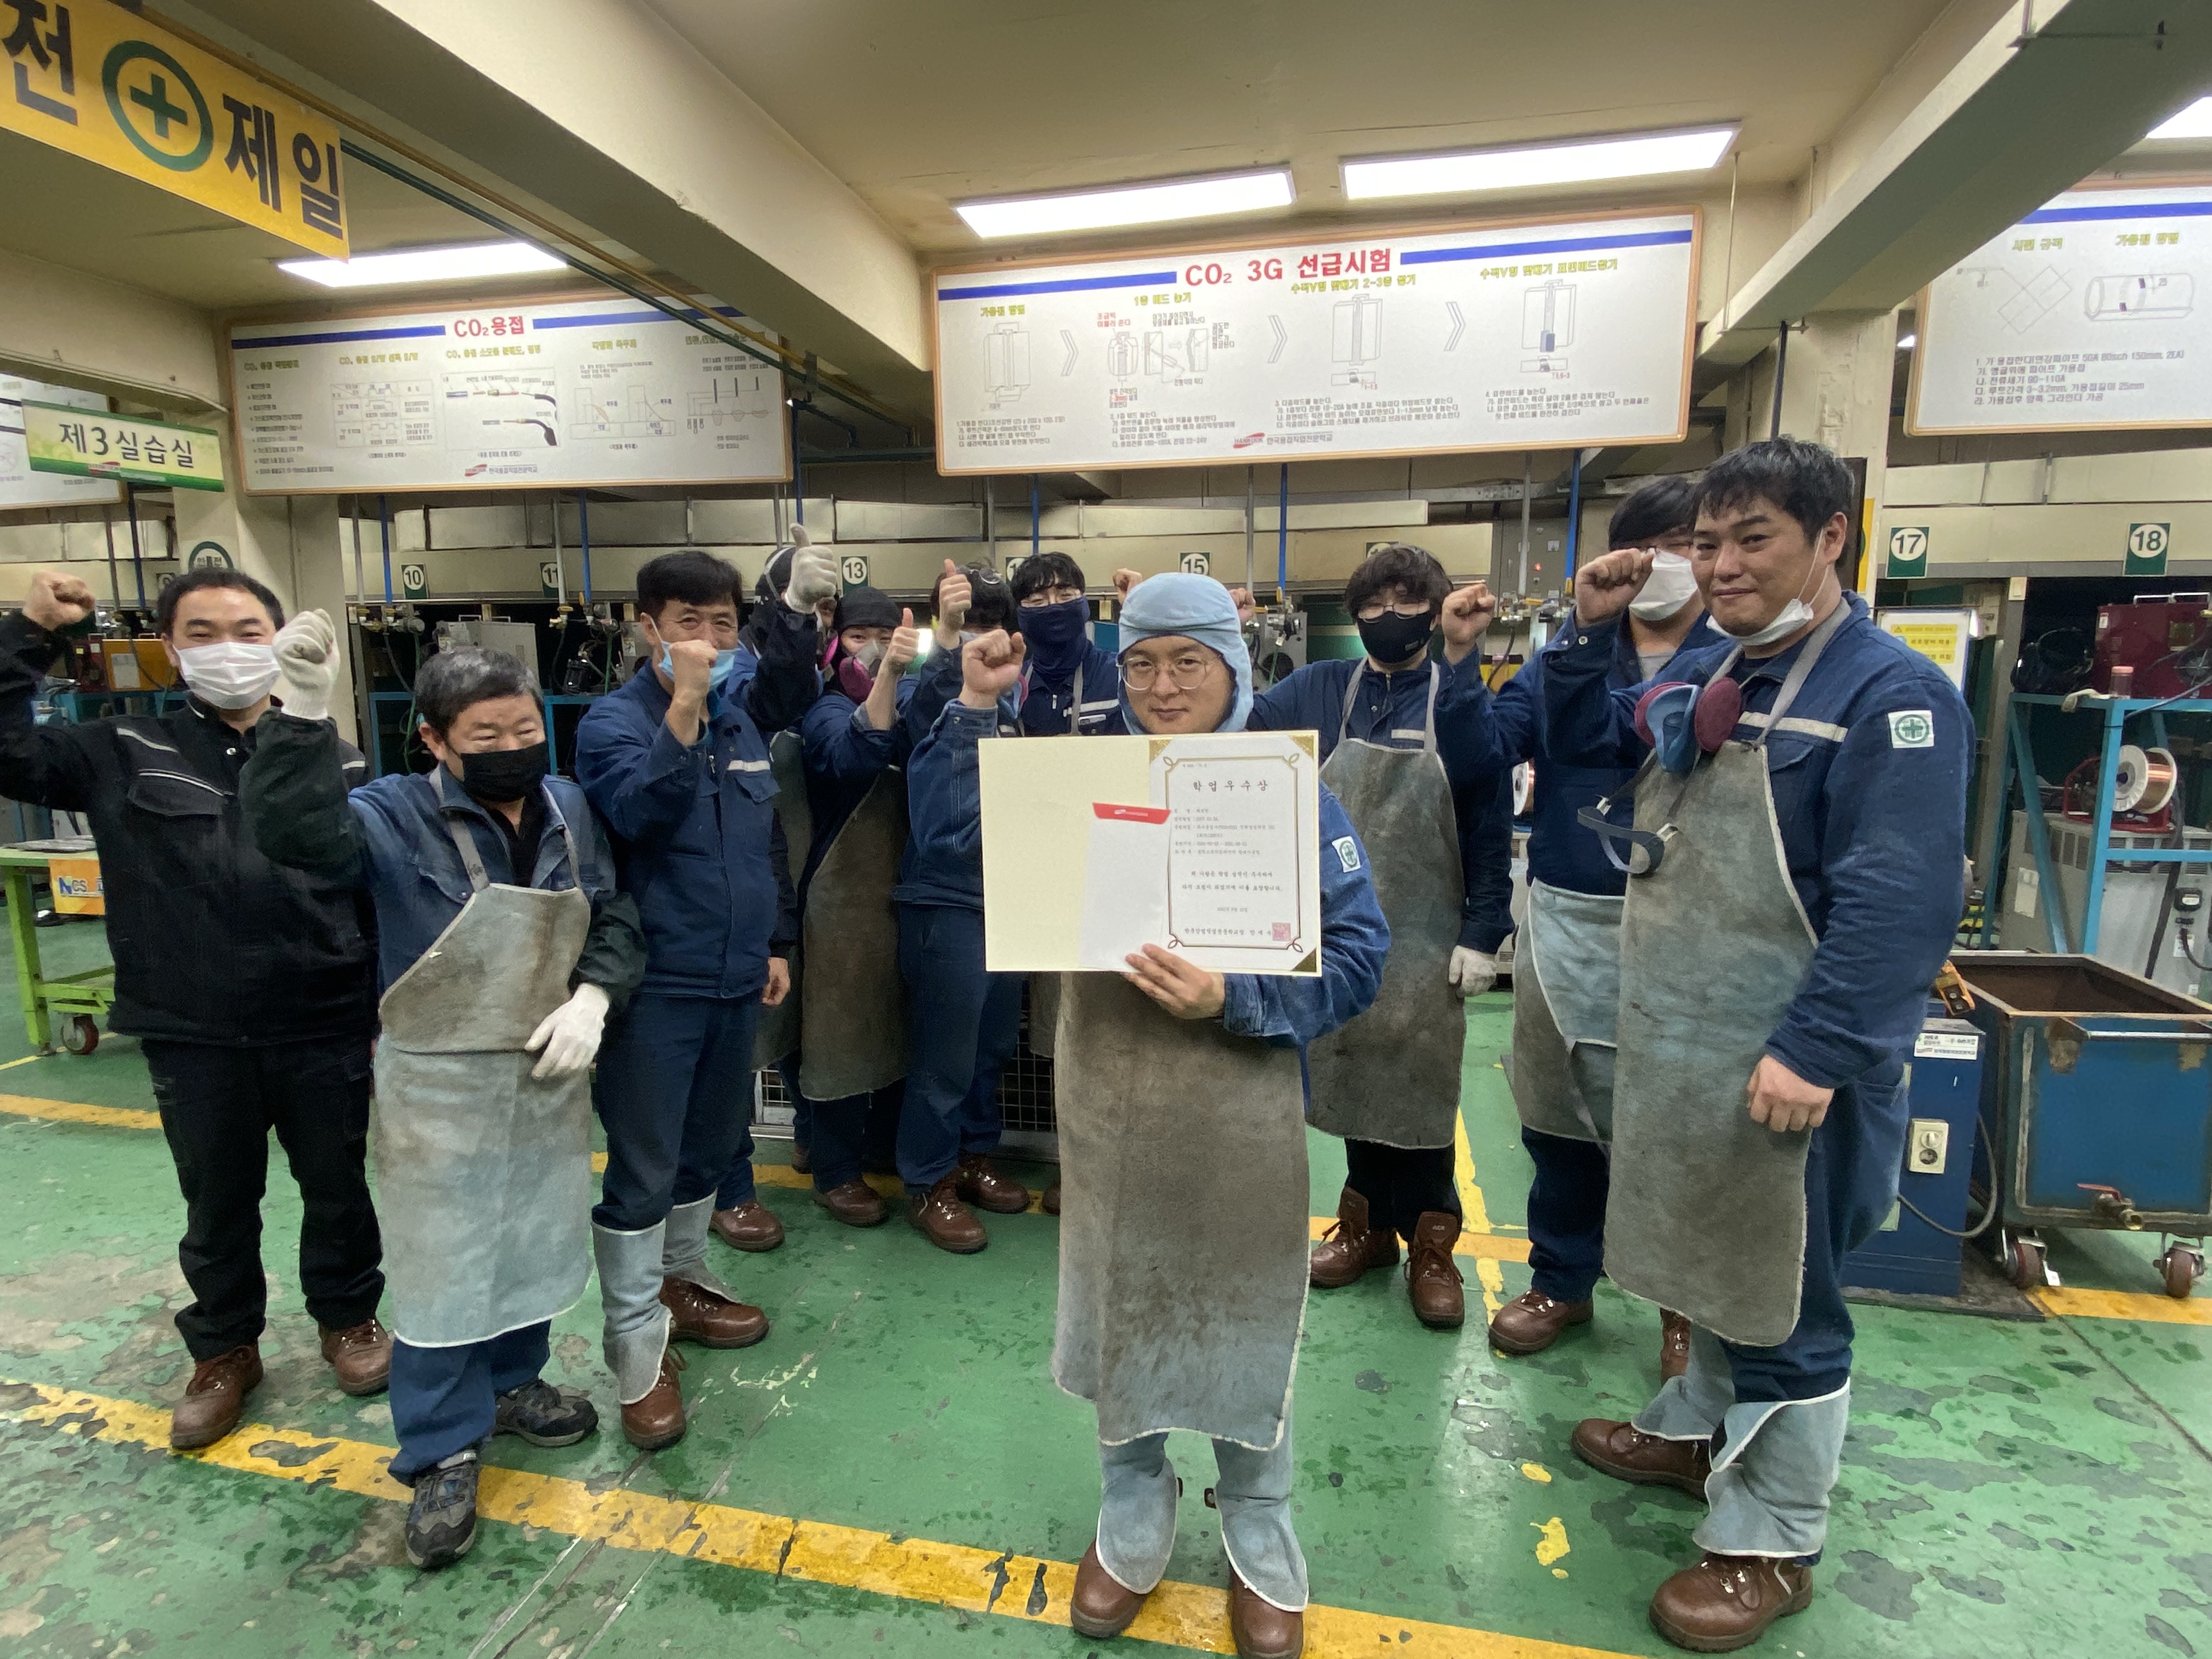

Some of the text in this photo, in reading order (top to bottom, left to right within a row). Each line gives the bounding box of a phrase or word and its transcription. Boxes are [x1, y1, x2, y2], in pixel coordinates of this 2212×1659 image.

[2, 0, 343, 240] 전 제일
[1248, 258, 1283, 281] 3G
[1297, 249, 1391, 278] 선급시험
[58, 422, 195, 469] 제3실습실
[1895, 534, 1923, 554] 17
[2134, 531, 2162, 551] 18
[845, 562, 864, 579] 13
[1184, 558, 1205, 574] 15
[405, 569, 421, 585] 10
